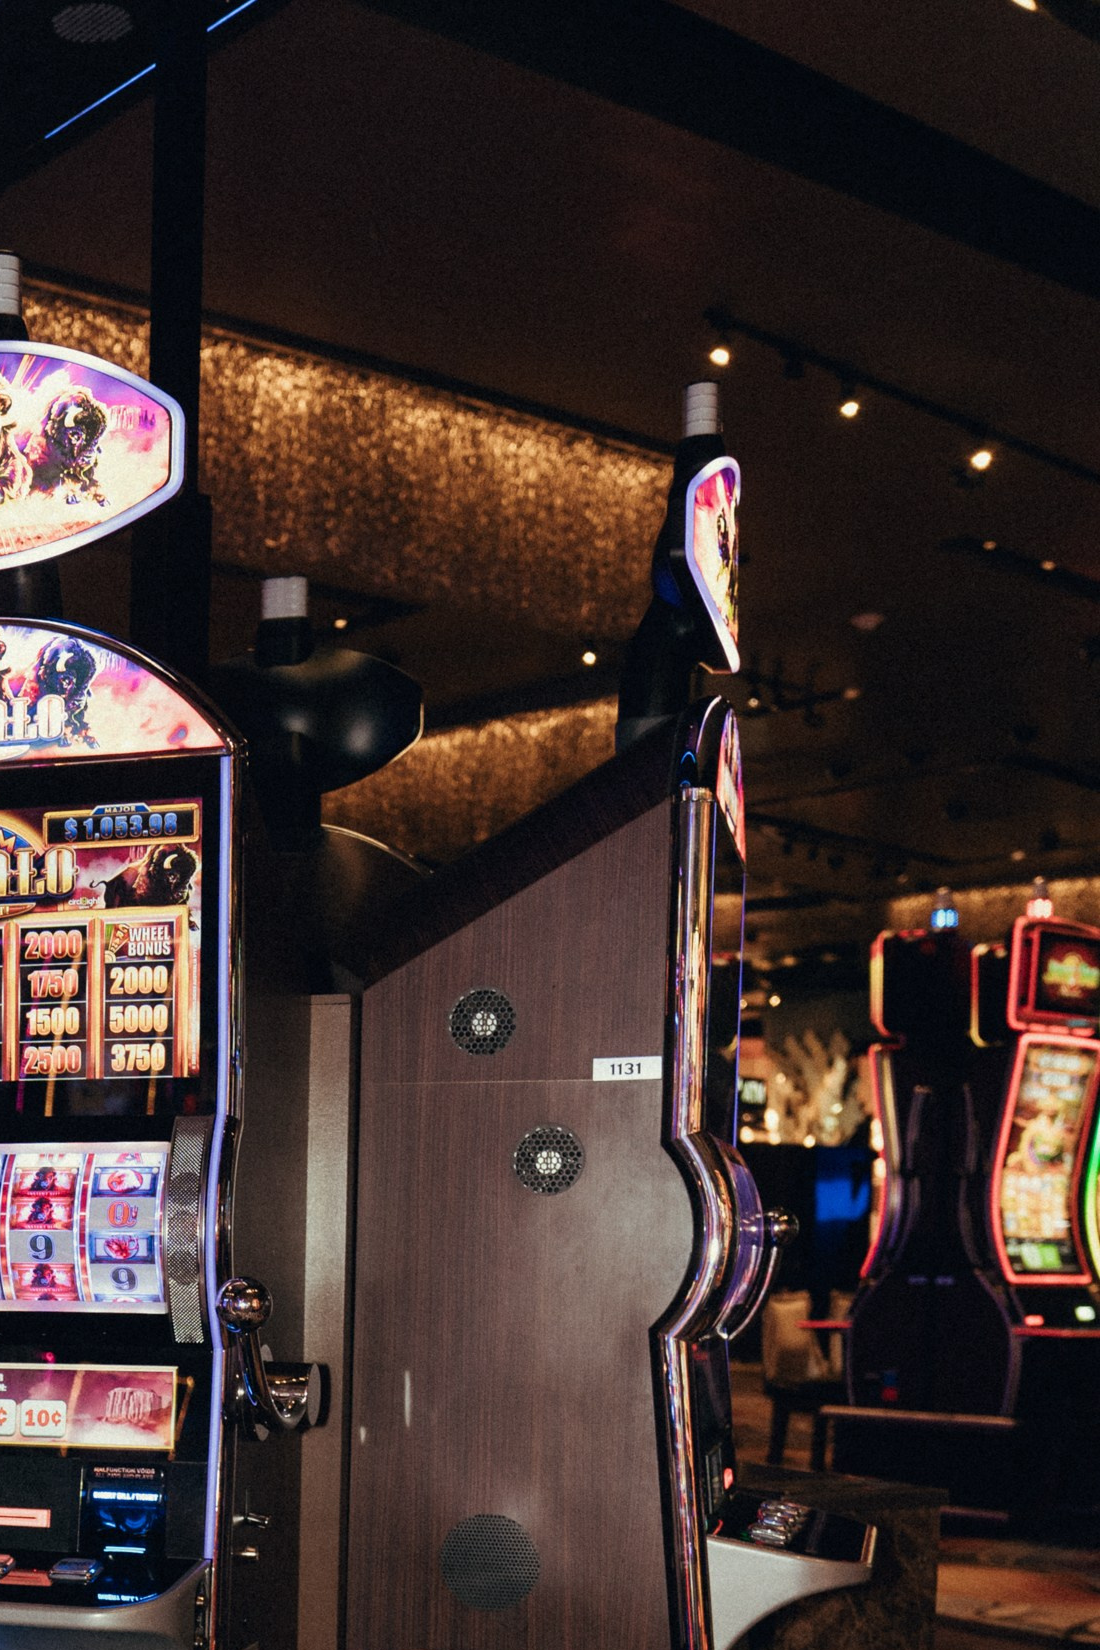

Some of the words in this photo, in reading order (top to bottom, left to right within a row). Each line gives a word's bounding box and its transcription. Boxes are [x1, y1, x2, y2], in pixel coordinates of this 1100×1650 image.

[104, 805, 136, 813] MAJOR
[63, 817, 78, 842] $
[83, 812, 177, 841] 1,053.98
[24, 929, 83, 959] 2000
[128, 924, 171, 942] WHEEL
[127, 941, 171, 957] BONUS
[27, 968, 79, 998] 1750
[109, 965, 168, 995] 2000
[26, 1006, 79, 1036] 1500
[109, 1004, 168, 1033] 5000
[24, 1045, 81, 1074] 2500
[111, 1042, 165, 1072] 3750
[610, 1062, 642, 1076] 1131
[108, 1200, 135, 1228] Q
[29, 1233, 54, 1261] 9
[111, 1267, 137, 1290] 9
[25, 1408, 62, 1428] 10¢
